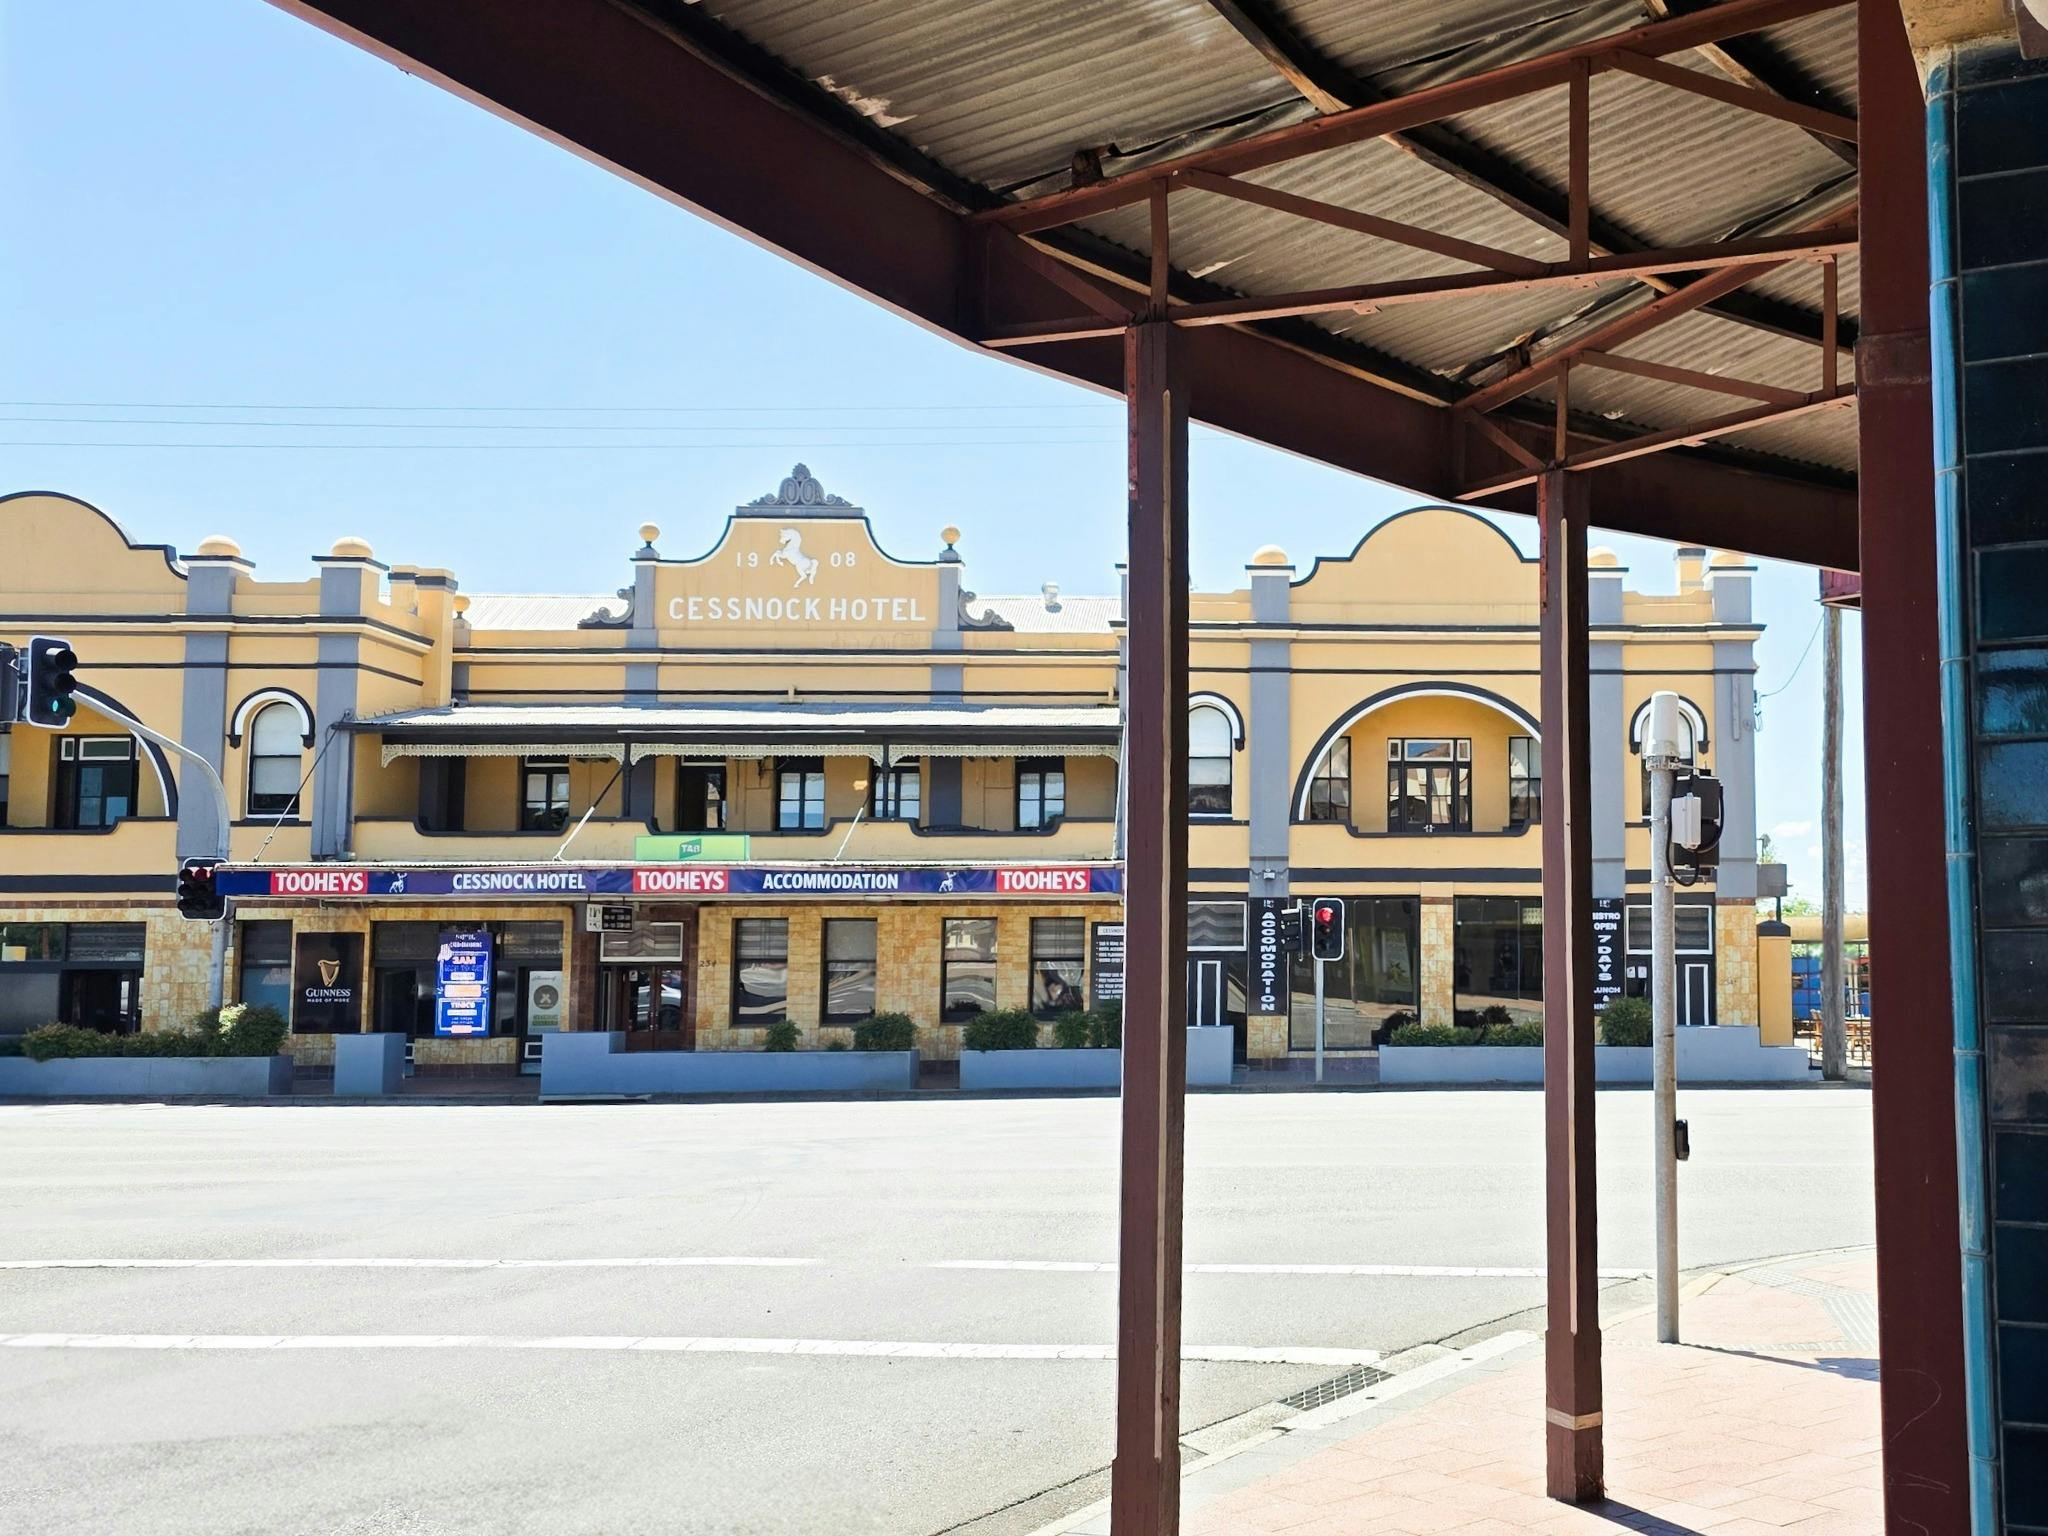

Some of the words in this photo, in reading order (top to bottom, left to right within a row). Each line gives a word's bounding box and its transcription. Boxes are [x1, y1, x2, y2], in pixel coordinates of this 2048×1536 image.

[737, 552, 758, 567] 19
[831, 552, 856, 567] 08
[669, 597, 821, 621] CESSNOCK
[829, 598, 926, 622] HOTEL
[681, 844, 700, 853] TAB
[275, 872, 364, 892] TOOHEYS
[452, 873, 534, 890] CESSNOCK
[536, 873, 586, 890] HOTEL
[637, 871, 725, 890] TOOHEYS
[762, 873, 899, 890] ACCOMMODATION
[1001, 871, 1087, 890] TOOHEYS
[1593, 922, 1617, 930] OPEN
[1260, 911, 1277, 1011] ACCOMODATION
[1598, 946, 1612, 981] DAYS
[305, 987, 352, 998] GUINNESS
